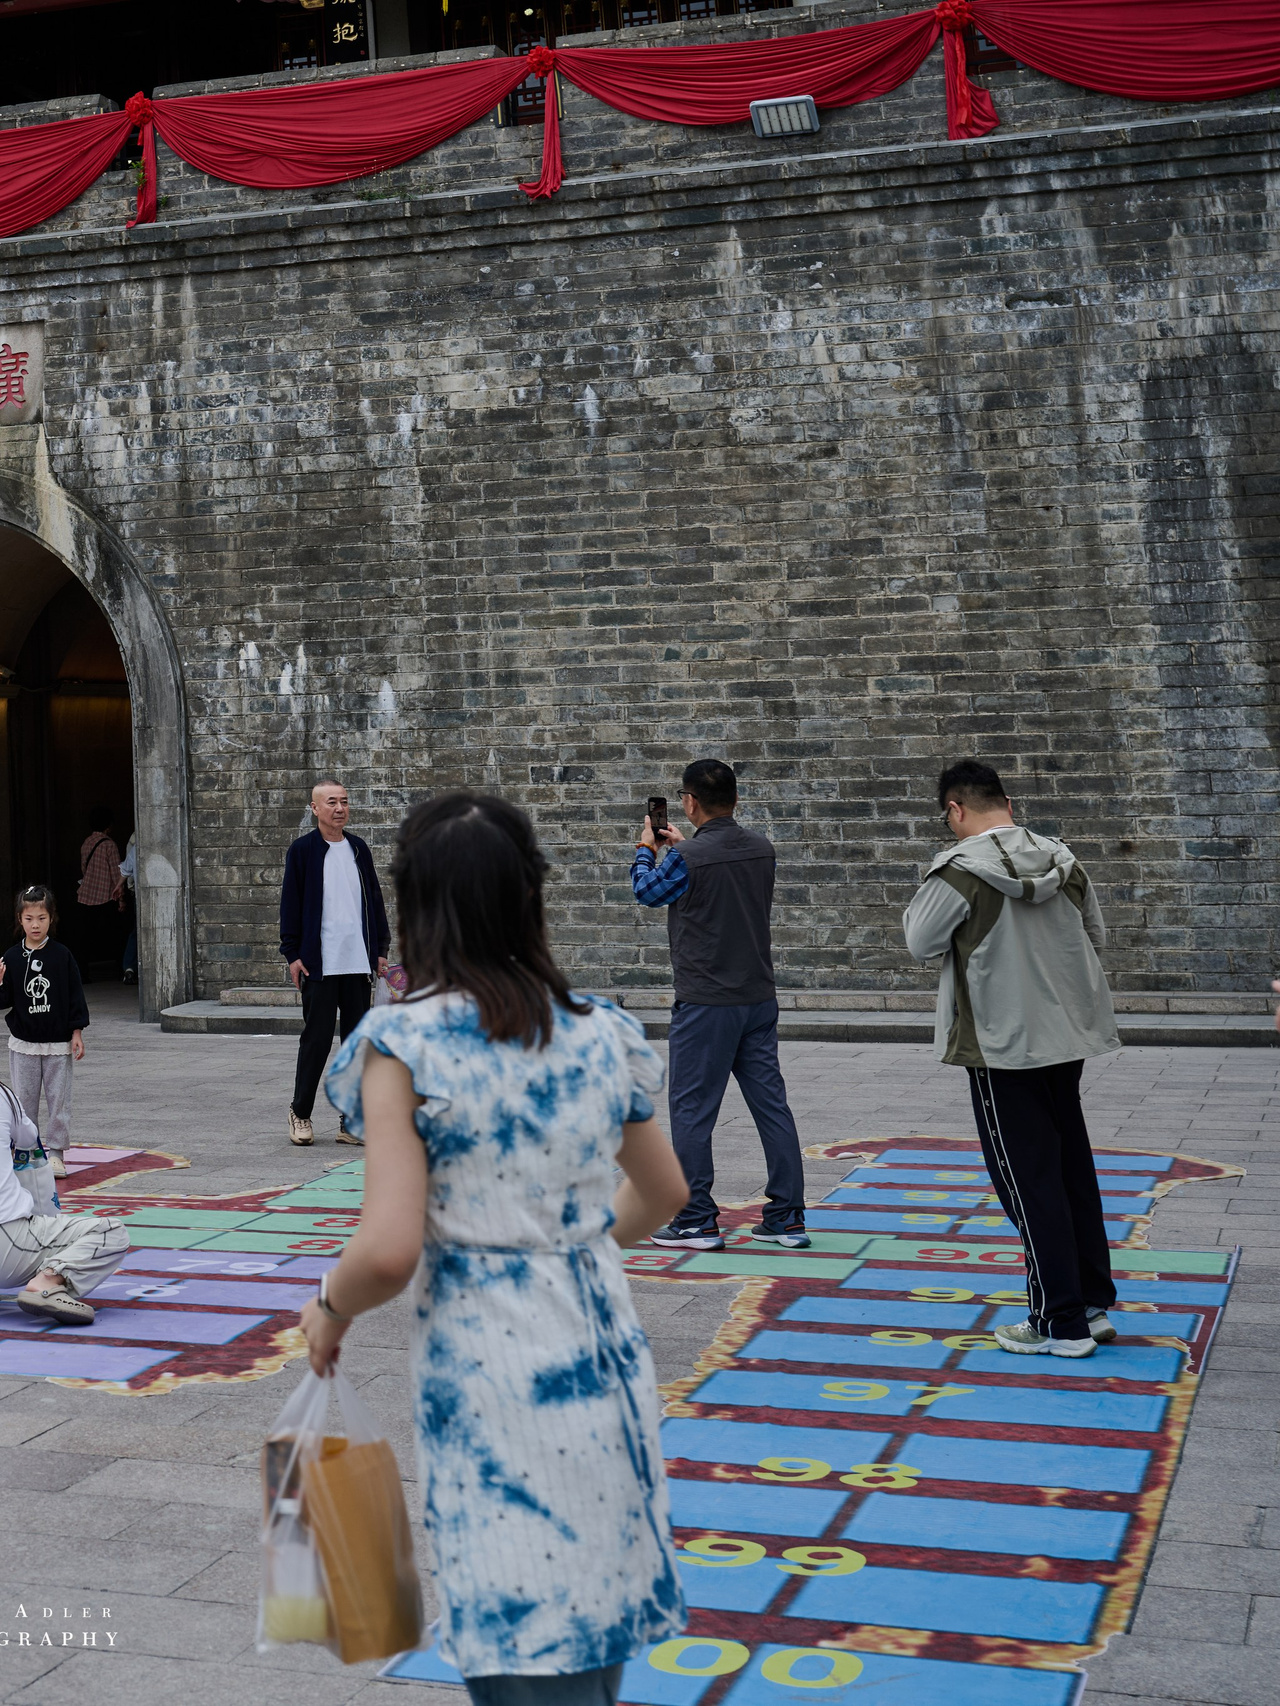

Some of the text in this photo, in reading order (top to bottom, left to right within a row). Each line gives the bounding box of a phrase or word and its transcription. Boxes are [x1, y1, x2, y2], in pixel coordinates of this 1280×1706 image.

[28, 1004, 51, 1014] CANDY
[933, 1172, 992, 1182] 9
[901, 1191, 1000, 1202] 93
[312, 1217, 361, 1228] 8
[900, 1213, 1010, 1227] 94
[286, 1239, 345, 1250] 8
[622, 1255, 677, 1267] 8
[915, 1248, 1026, 1264] 90
[166, 1258, 280, 1275] 79
[907, 1287, 1029, 1306] 95
[868, 1330, 1002, 1351] 96
[819, 1381, 976, 1406] 97
[751, 1457, 922, 1489] 98
[676, 1537, 867, 1576] 99
[647, 1636, 864, 1689] 00
